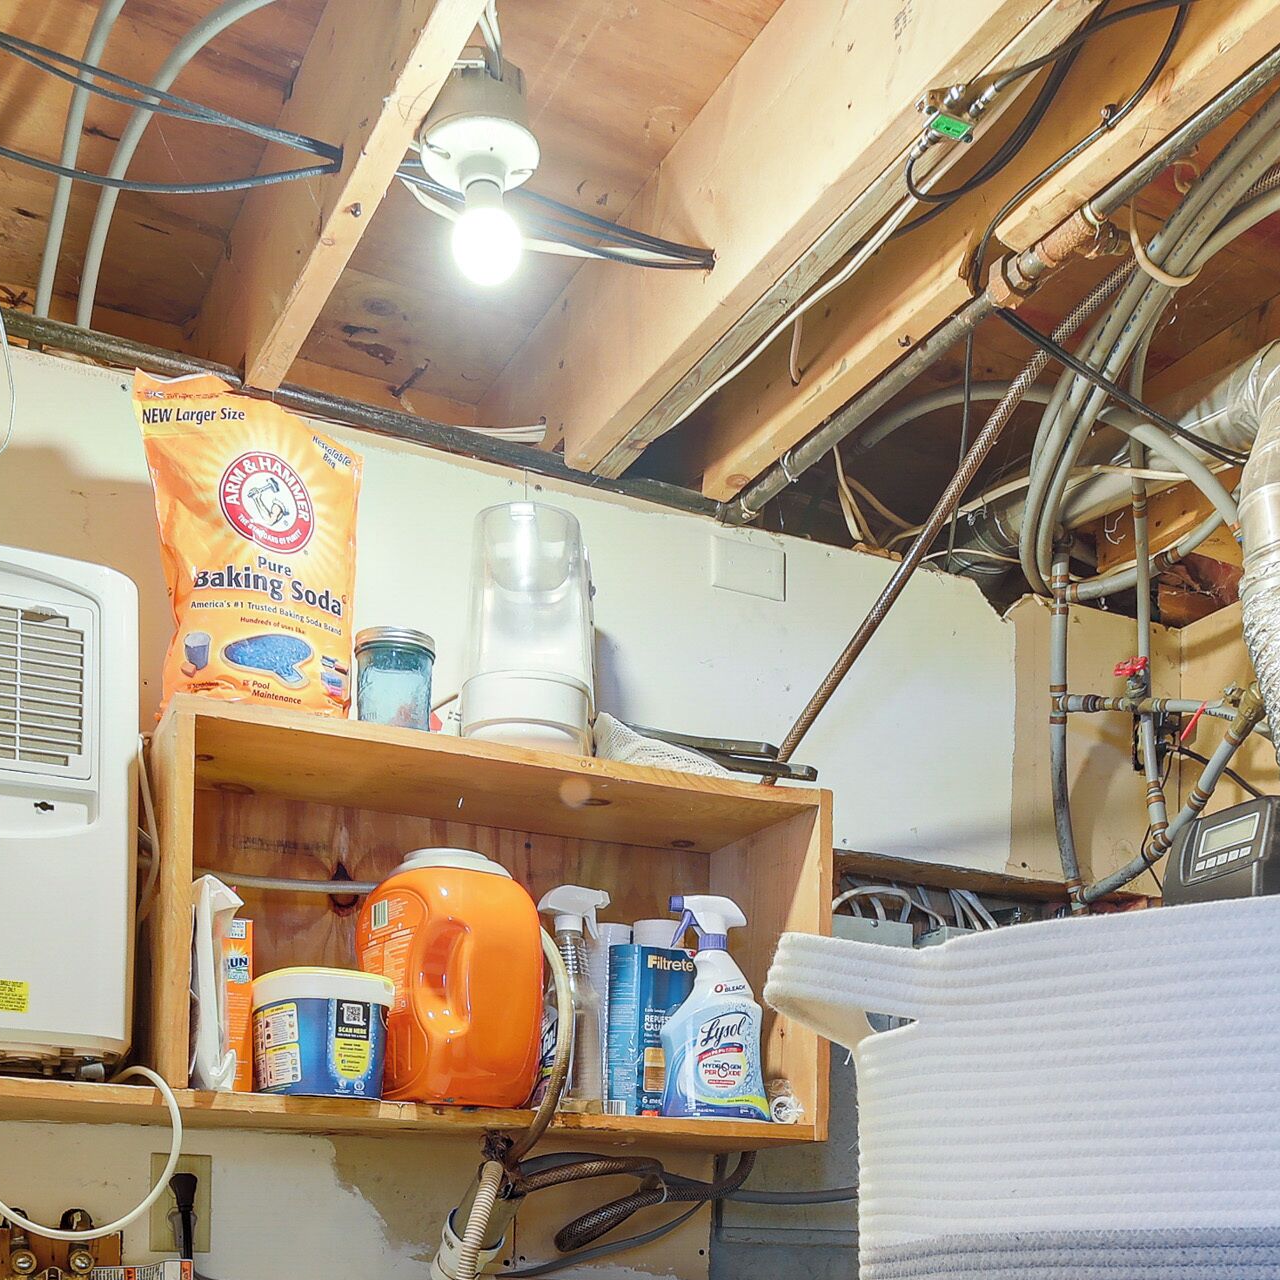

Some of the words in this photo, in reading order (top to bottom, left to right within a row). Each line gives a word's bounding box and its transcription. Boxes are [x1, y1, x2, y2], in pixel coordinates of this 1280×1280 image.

[142, 408, 172, 424] NEW
[176, 408, 216, 424] Larger
[220, 408, 244, 420] Size
[226, 468, 246, 505] ARM
[243, 460, 258, 472] &
[258, 457, 310, 522] HAMMER
[258, 556, 291, 576] Pure
[194, 565, 283, 601] Baking
[291, 580, 342, 616] Soda
[240, 617, 271, 625] Hundreds
[248, 602, 276, 613] Trusted
[280, 606, 304, 623] Baking
[306, 616, 321, 628] Soda
[323, 622, 342, 635] Brand
[252, 680, 270, 689] Pool
[252, 689, 301, 704] Maintenance
[648, 955, 693, 971] Filtrete
[700, 1017, 746, 1047] Lysol
[702, 1062, 741, 1071] HYDROGEN
[705, 1068, 740, 1078] PEROXIDE
[642, 1096, 648, 1104] 6
